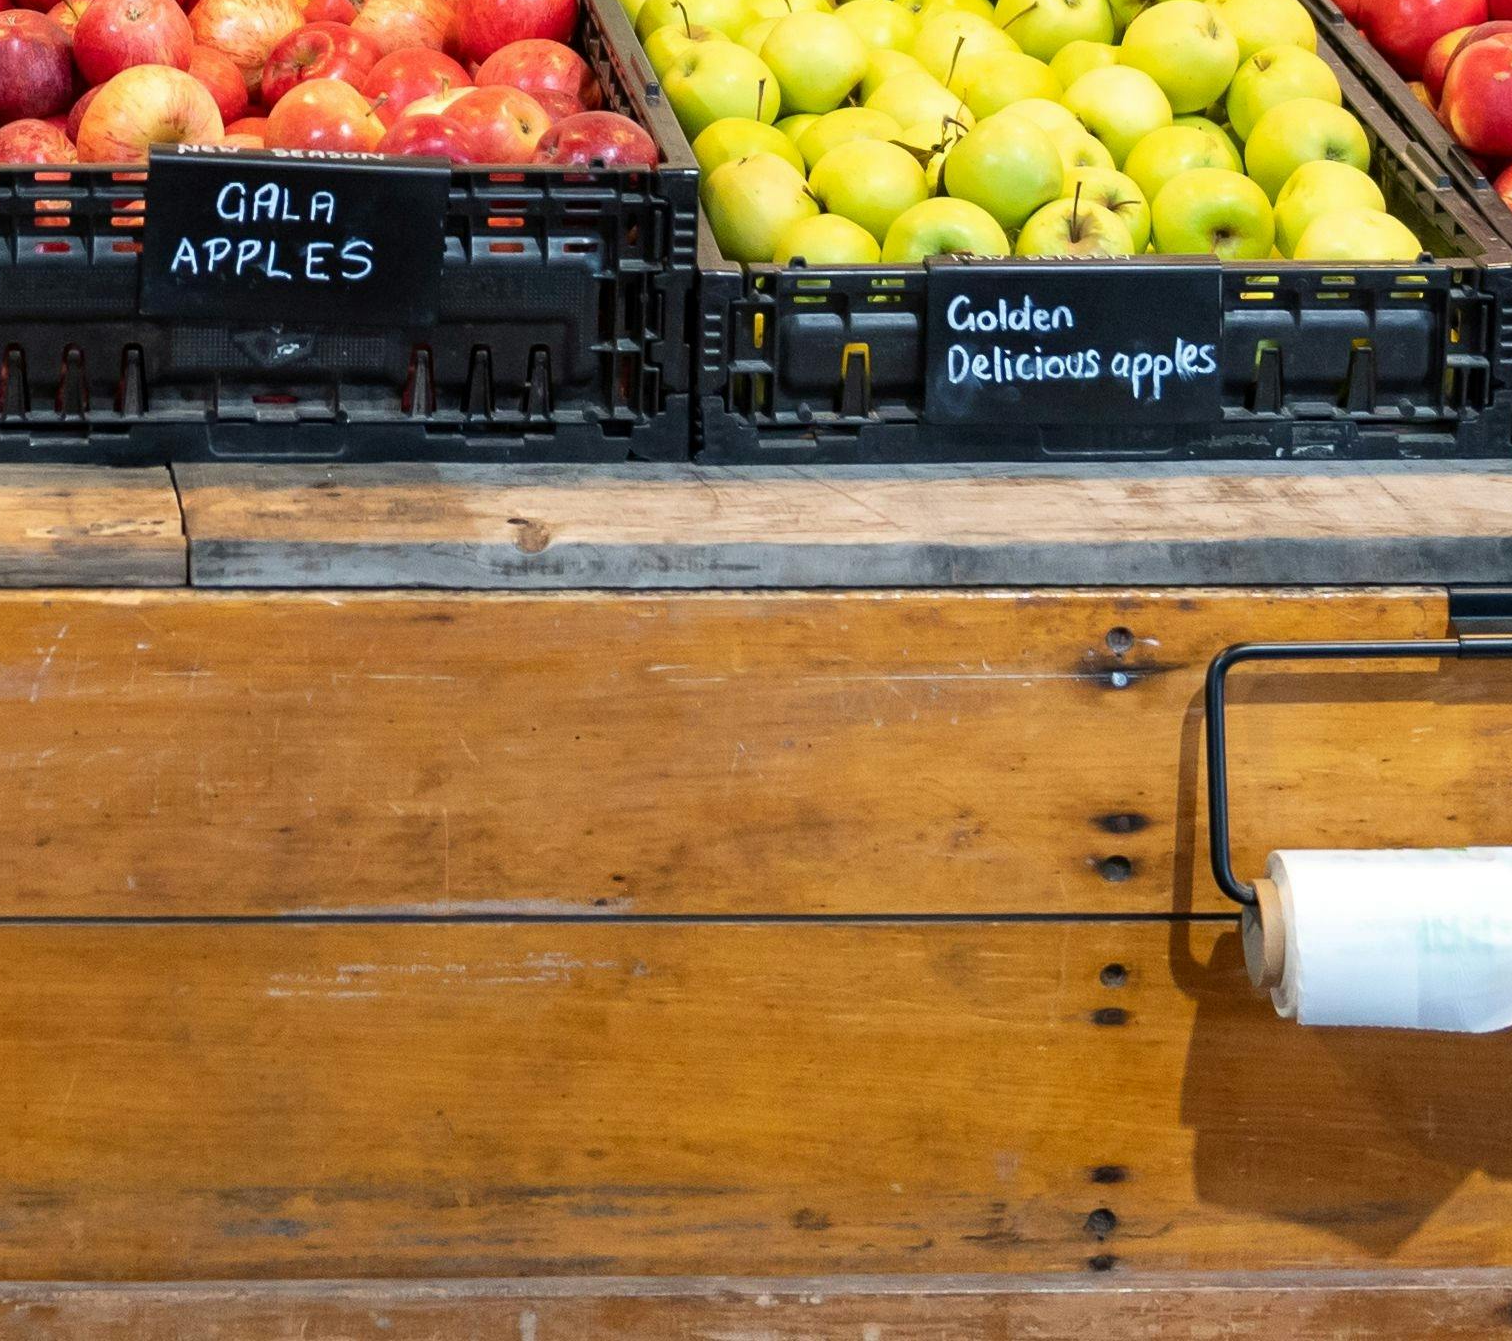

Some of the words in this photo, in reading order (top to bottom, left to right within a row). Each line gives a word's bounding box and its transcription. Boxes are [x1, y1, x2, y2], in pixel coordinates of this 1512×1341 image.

[216, 181, 336, 224] GALA
[170, 235, 374, 281] APPLES
[946, 294, 1075, 332] Golden
[948, 343, 1102, 385] Delicious
[1111, 335, 1218, 401] apples
